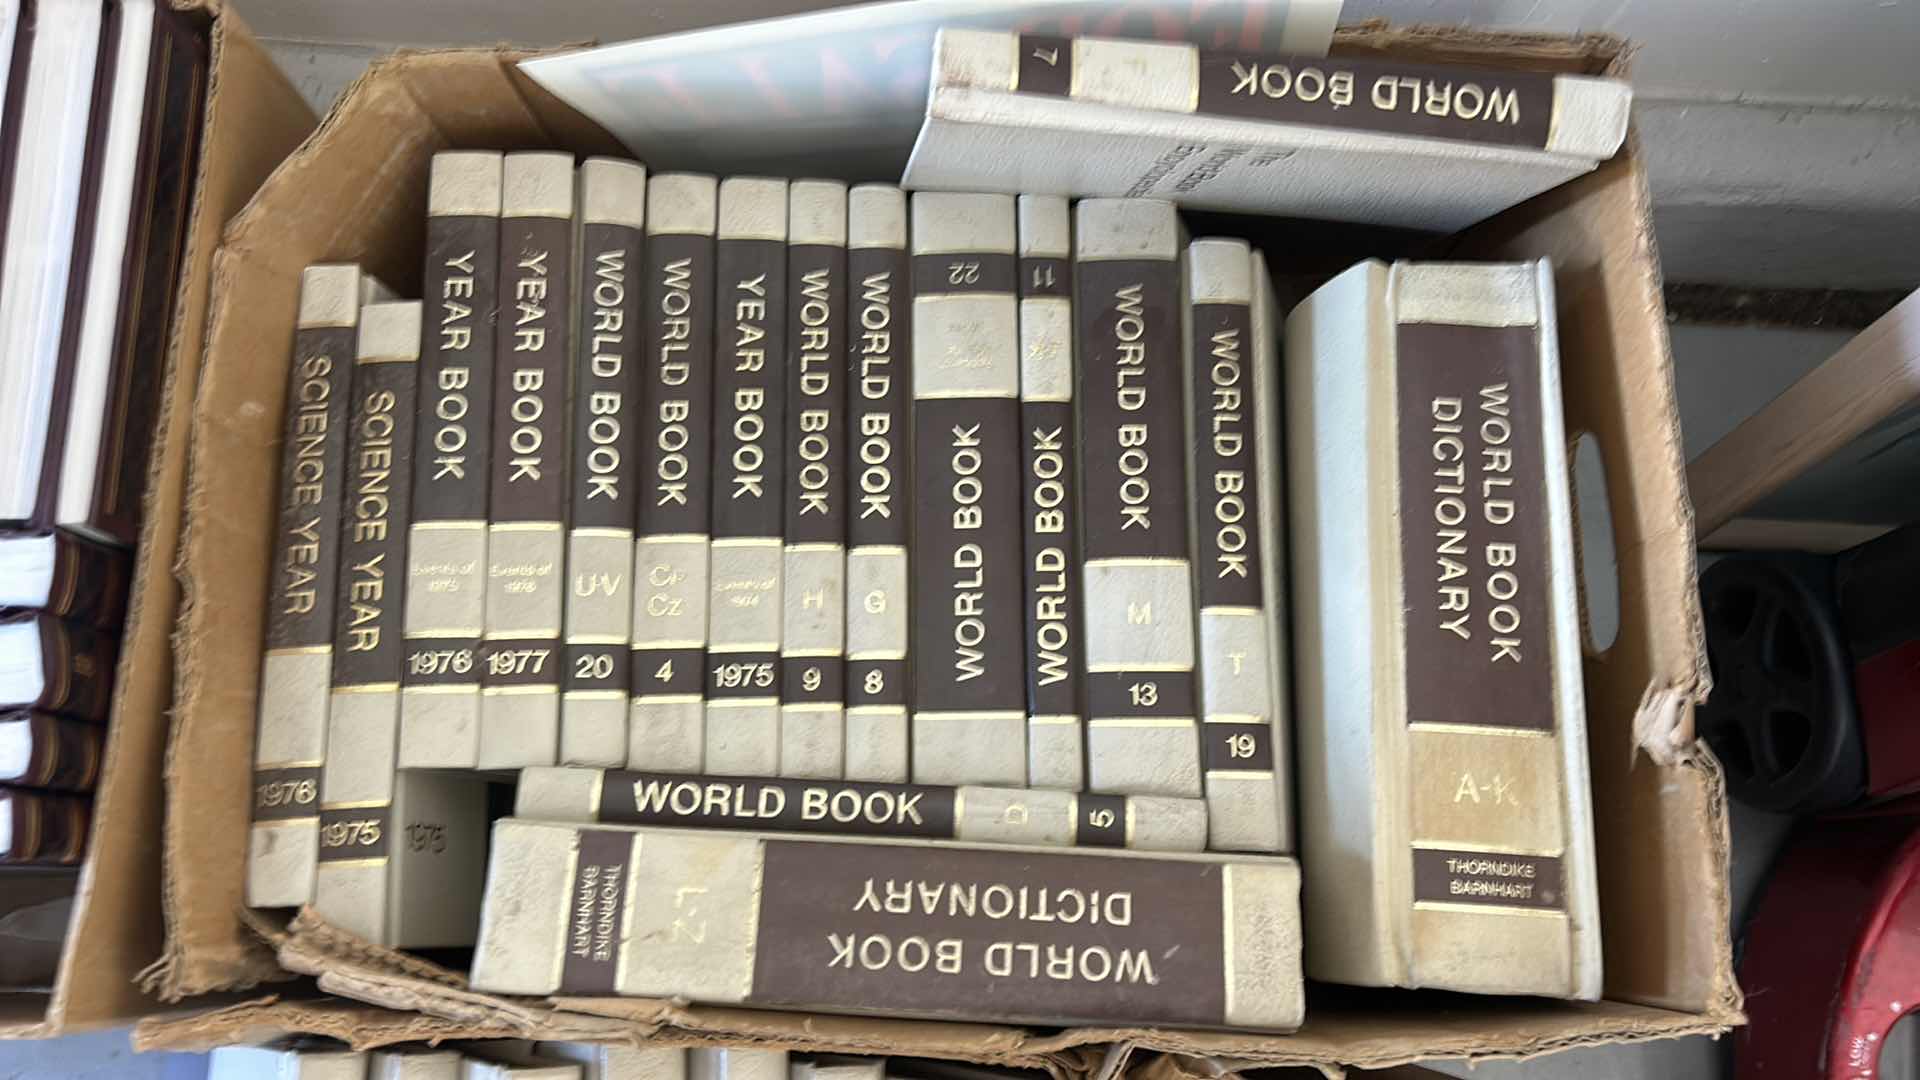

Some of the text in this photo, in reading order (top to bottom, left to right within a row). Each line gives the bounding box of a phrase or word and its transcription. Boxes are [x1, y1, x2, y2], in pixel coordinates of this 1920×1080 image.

[1033, 47, 1058, 66] 7
[1230, 60, 1521, 125] WORLD BOOK
[948, 262, 980, 285] 22
[1033, 263, 1055, 288] 11
[433, 250, 475, 481] YEAR BOOK
[509, 250, 548, 482] YEAR BOOK
[587, 249, 626, 500] WORLD BOOK
[657, 257, 692, 506] WORLD BOOK
[732, 272, 767, 499] YEAR BOOK
[799, 268, 830, 515] WORLD BOOK
[859, 271, 891, 520] WORLD BOOK
[1115, 283, 1150, 530] WORLD BOOK
[1210, 328, 1247, 579] WORLD BOOK
[284, 354, 332, 614] SCIENCE YEAR
[347, 390, 396, 652] SCIENCE YEAR
[1432, 397, 1471, 640] DICTIONARY
[1479, 382, 1522, 663] WORLD BOOK
[952, 424, 986, 682] WORLD BOOK
[1033, 426, 1069, 686] WORLD BOOK
[647, 593, 683, 617] Cz
[803, 589, 824, 610] H
[864, 590, 887, 614] G
[1127, 602, 1151, 625] M
[408, 649, 474, 675] 1976
[487, 649, 551, 675] 1977
[575, 654, 614, 679] 20
[654, 659, 675, 682] 4
[712, 663, 775, 688] 1975
[1228, 652, 1247, 675] T
[802, 668, 822, 692] 9
[864, 670, 884, 694] 8
[1128, 683, 1158, 706] 13
[1226, 734, 1256, 758] 19
[256, 778, 318, 807] 1976
[633, 779, 924, 825] WORLD BOOK
[1454, 772, 1519, 806] A-K
[321, 819, 382, 846] 1975
[1089, 808, 1116, 829] 5
[1447, 859, 1536, 878] THORNDIKE
[853, 877, 1132, 926] DICTIONARY
[1450, 880, 1534, 899] BARNHART
[573, 865, 600, 958] BARNHART
[593, 864, 622, 961] THORNDIKE
[826, 933, 1159, 985] WORLD BOOK
